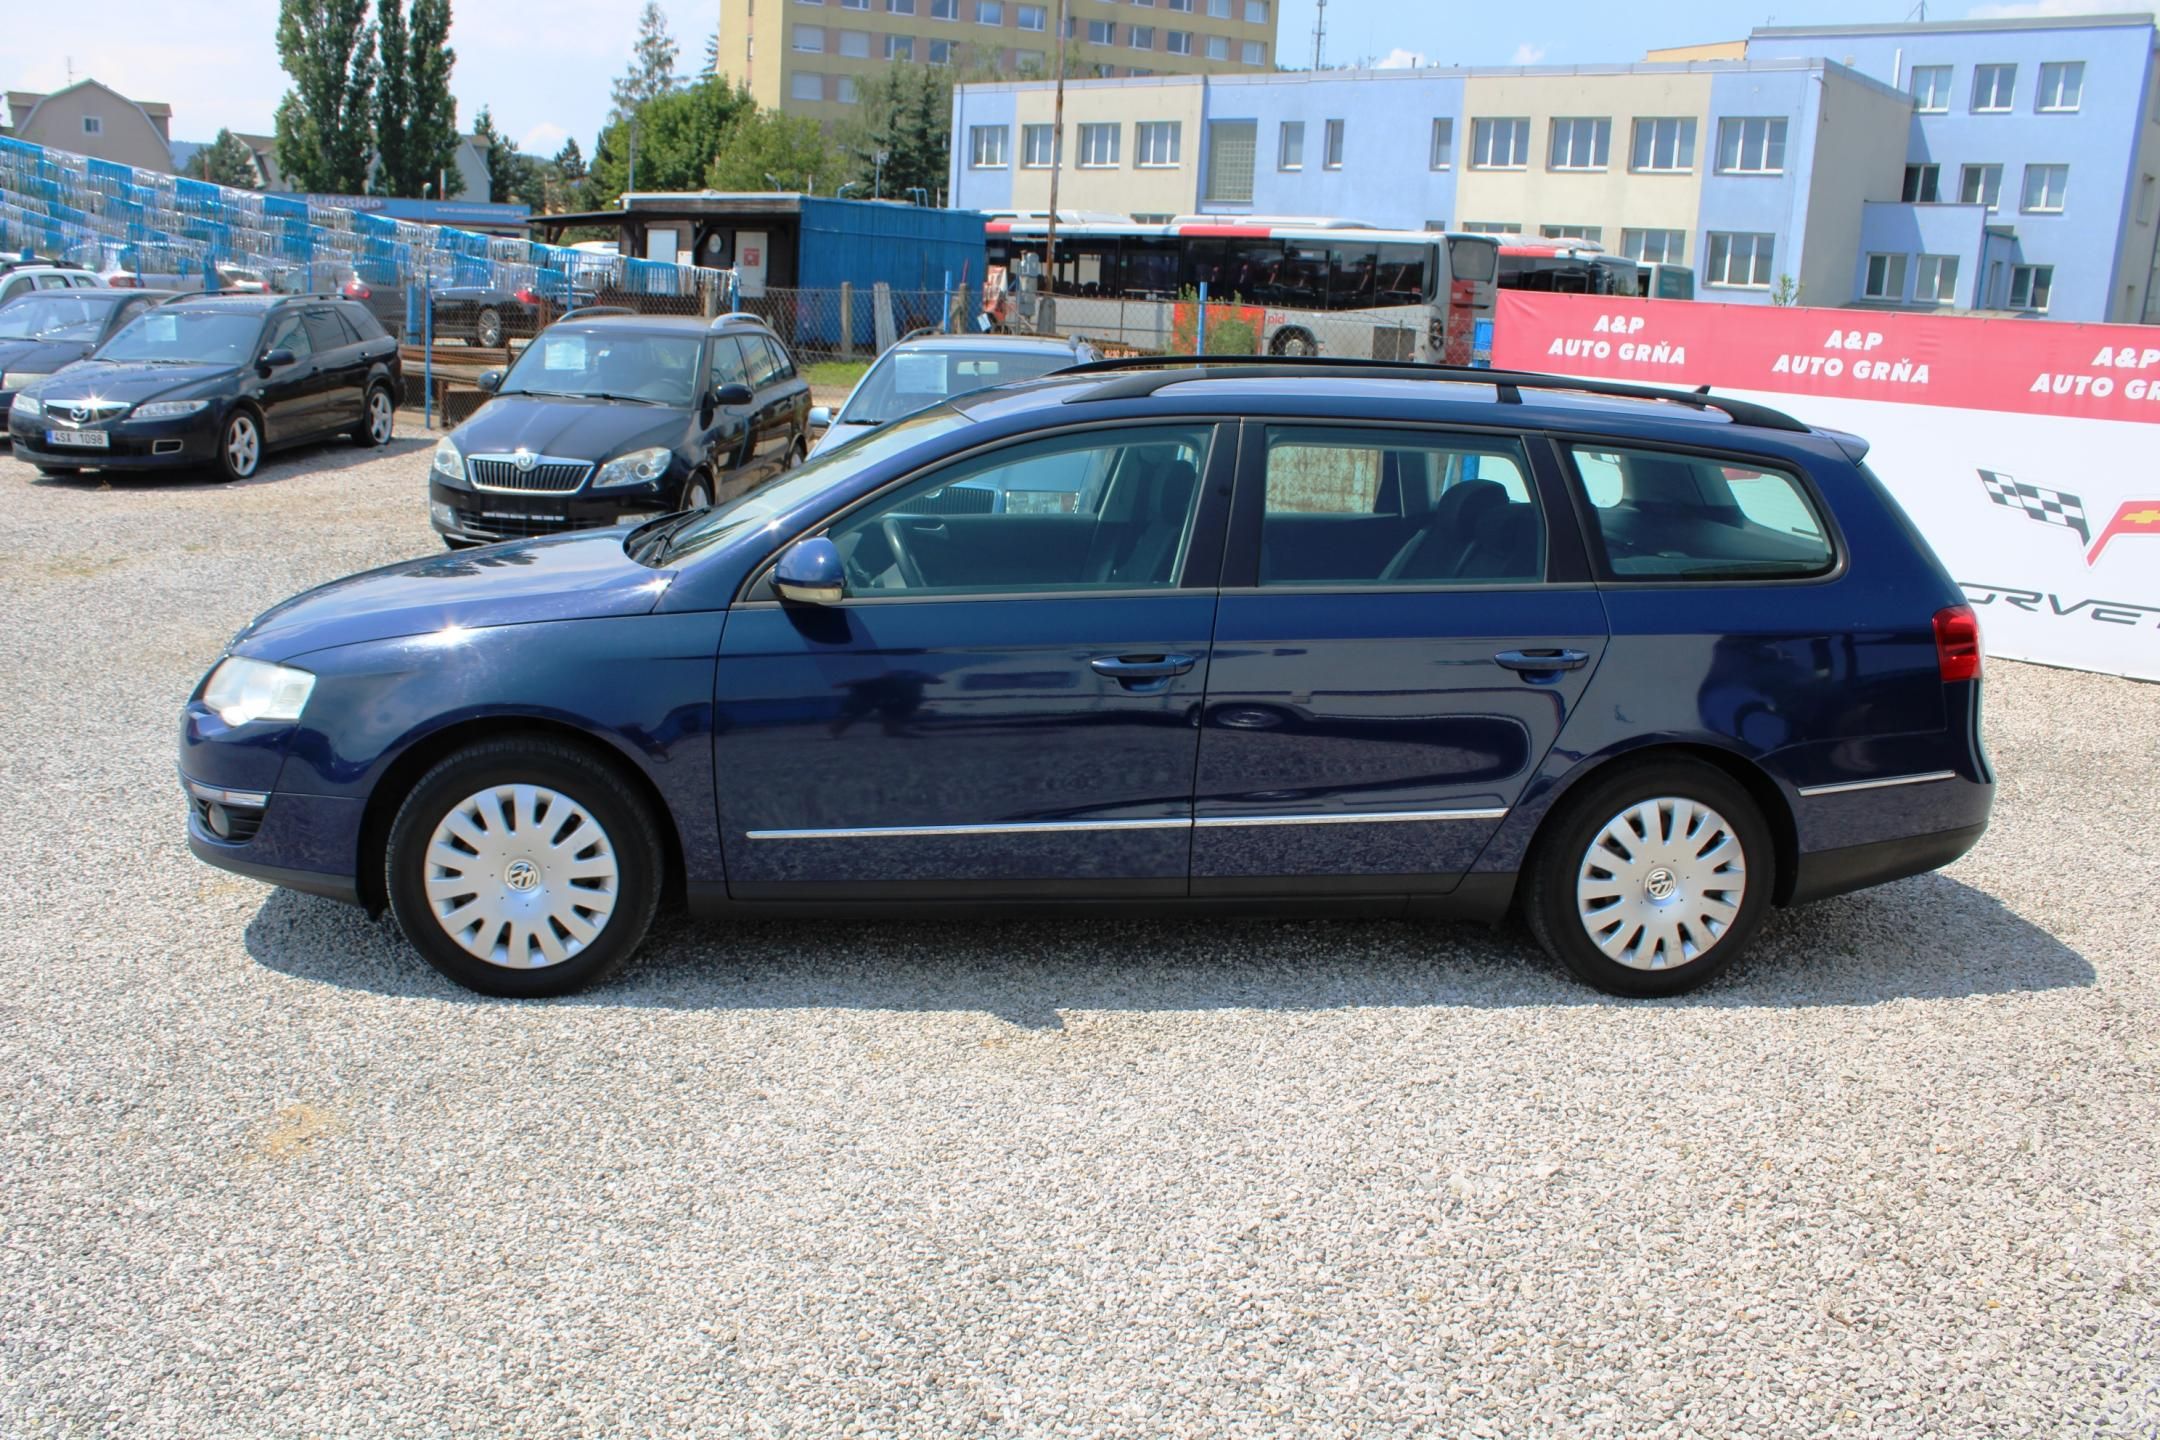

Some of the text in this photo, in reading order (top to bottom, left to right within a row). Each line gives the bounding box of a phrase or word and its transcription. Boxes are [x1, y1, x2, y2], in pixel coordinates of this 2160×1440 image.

[1593, 315, 1645, 334] A&P
[1548, 337, 1686, 365] AUTO GRŇA
[1824, 329, 1884, 351] A&P
[1772, 354, 1930, 384] AUTO GRŇA
[2091, 346, 2160, 369] A&P
[2029, 373, 2115, 398] AUTO
